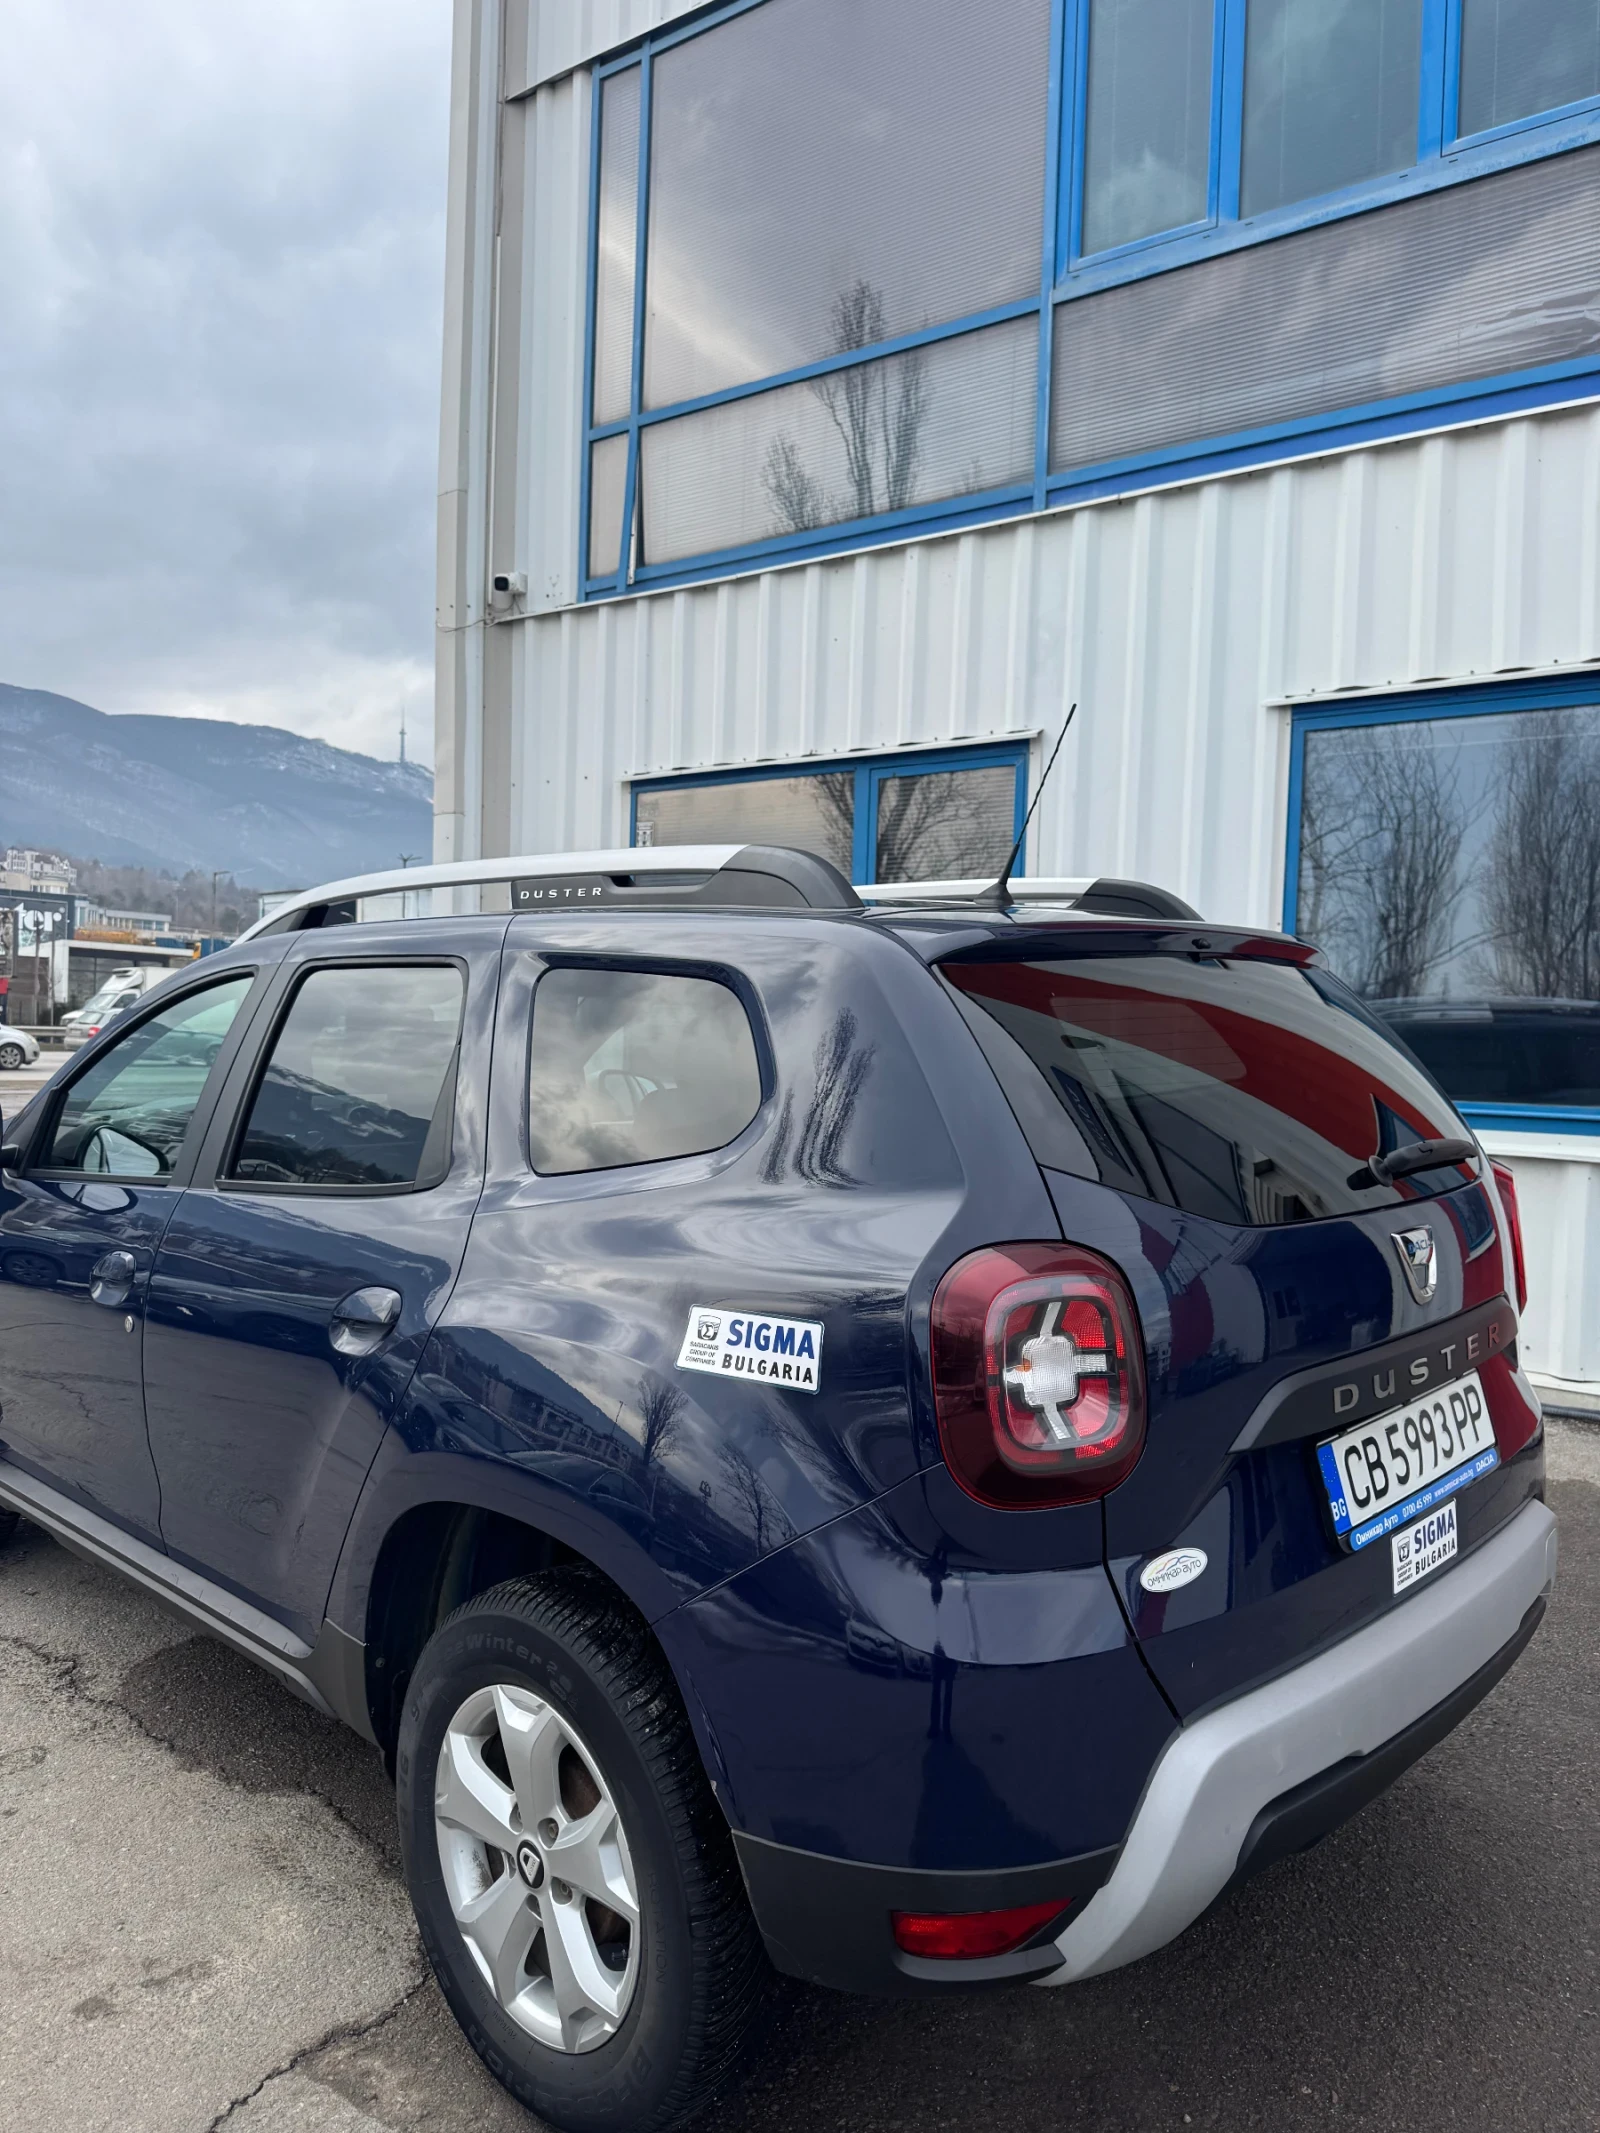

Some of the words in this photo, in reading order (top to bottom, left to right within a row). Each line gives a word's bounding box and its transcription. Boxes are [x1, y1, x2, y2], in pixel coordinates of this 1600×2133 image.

[520, 887, 602, 900] DUSTER
[726, 1319, 815, 1360] SIGMA
[721, 1353, 813, 1384] BULGARIA
[1333, 1322, 1500, 1414] DUSTER
[1475, 1454, 1495, 1472] DACIA
[1330, 1498, 1347, 1521] BG
[1414, 1508, 1455, 1554] SIGMA
[1415, 1537, 1456, 1575] BULGARIA
